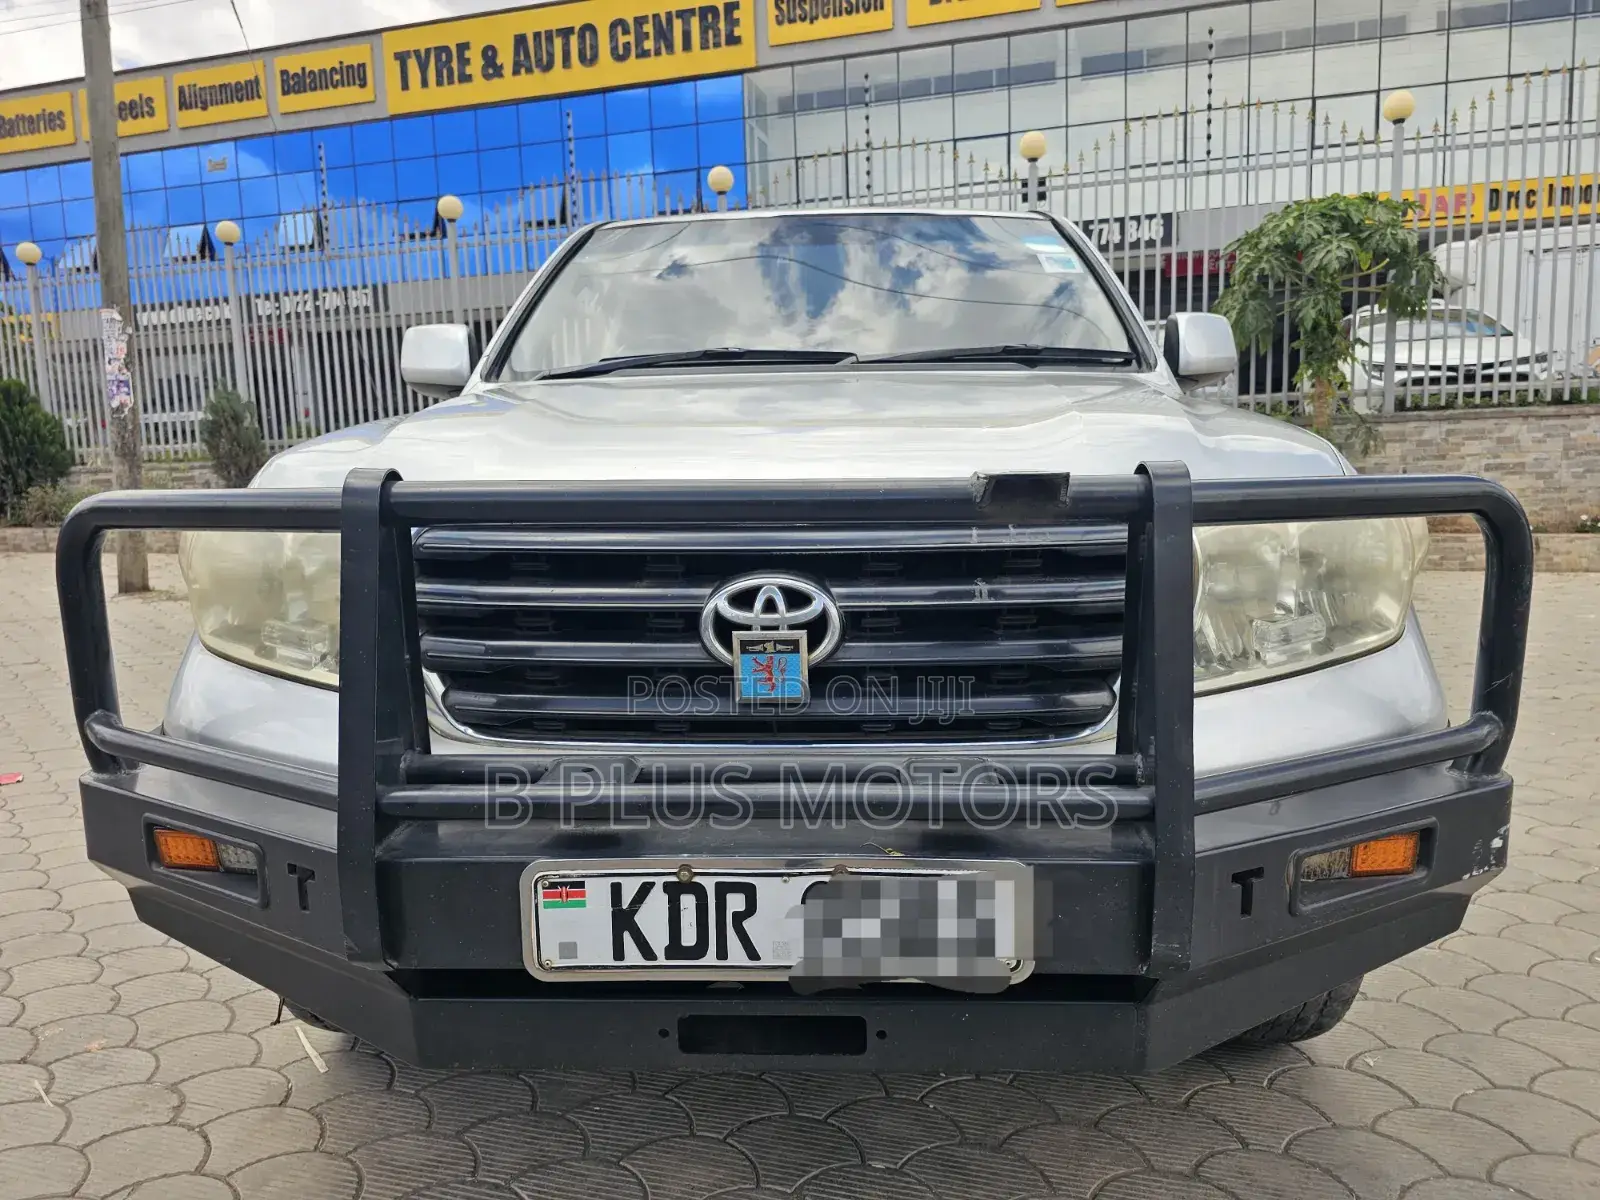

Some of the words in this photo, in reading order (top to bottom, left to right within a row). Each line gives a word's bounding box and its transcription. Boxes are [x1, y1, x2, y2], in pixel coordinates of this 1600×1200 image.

[394, 42, 474, 91] TYRE
[481, 44, 504, 81] &
[511, 23, 599, 77] AUTO
[608, 1, 743, 63] CENTRE
[178, 75, 262, 111] Alignment
[279, 61, 367, 96] Balancing
[0, 109, 66, 139] Batteries
[118, 94, 156, 122] eels
[1127, 218, 1164, 243] 846
[610, 880, 762, 962] KDR
